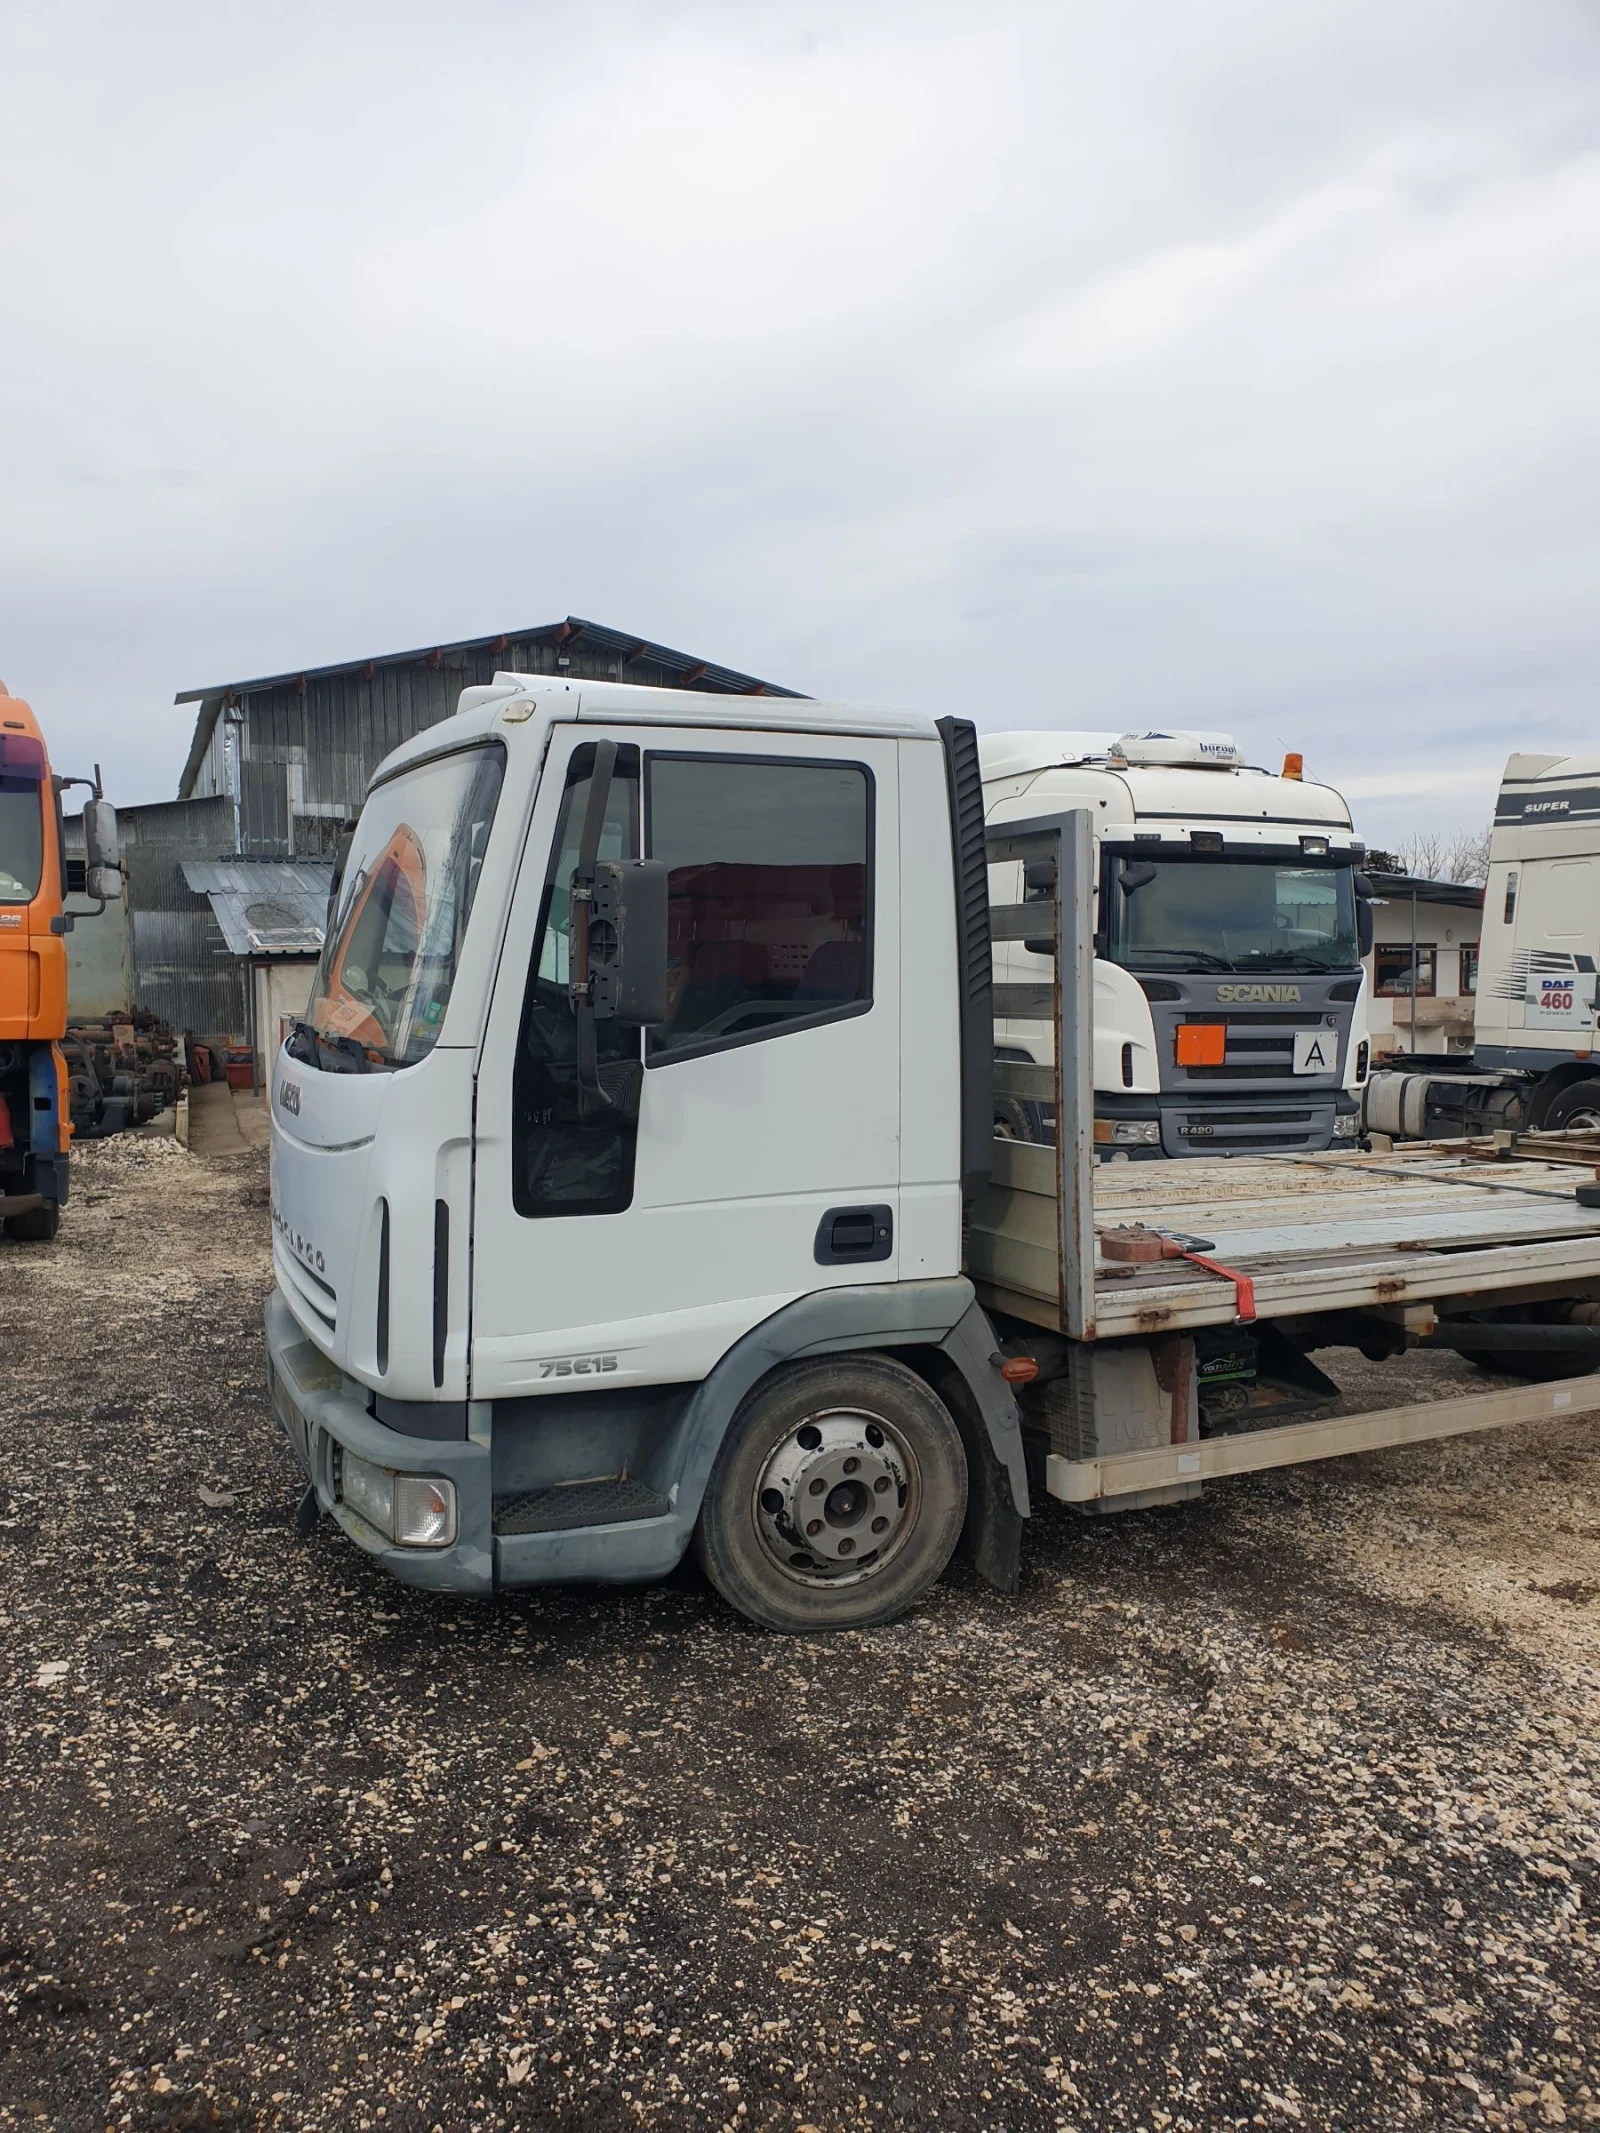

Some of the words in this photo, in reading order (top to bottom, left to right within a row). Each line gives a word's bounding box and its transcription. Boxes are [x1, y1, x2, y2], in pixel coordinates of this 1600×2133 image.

[1524, 800, 1570, 813] SUPER
[1216, 984, 1302, 1003] SCANIA
[1541, 980, 1575, 989] DAF
[1540, 992, 1573, 1010] 460
[1304, 1038, 1326, 1067] A
[539, 1355, 618, 1379] 75E15
[1114, 1420, 1170, 1442] IVEC
